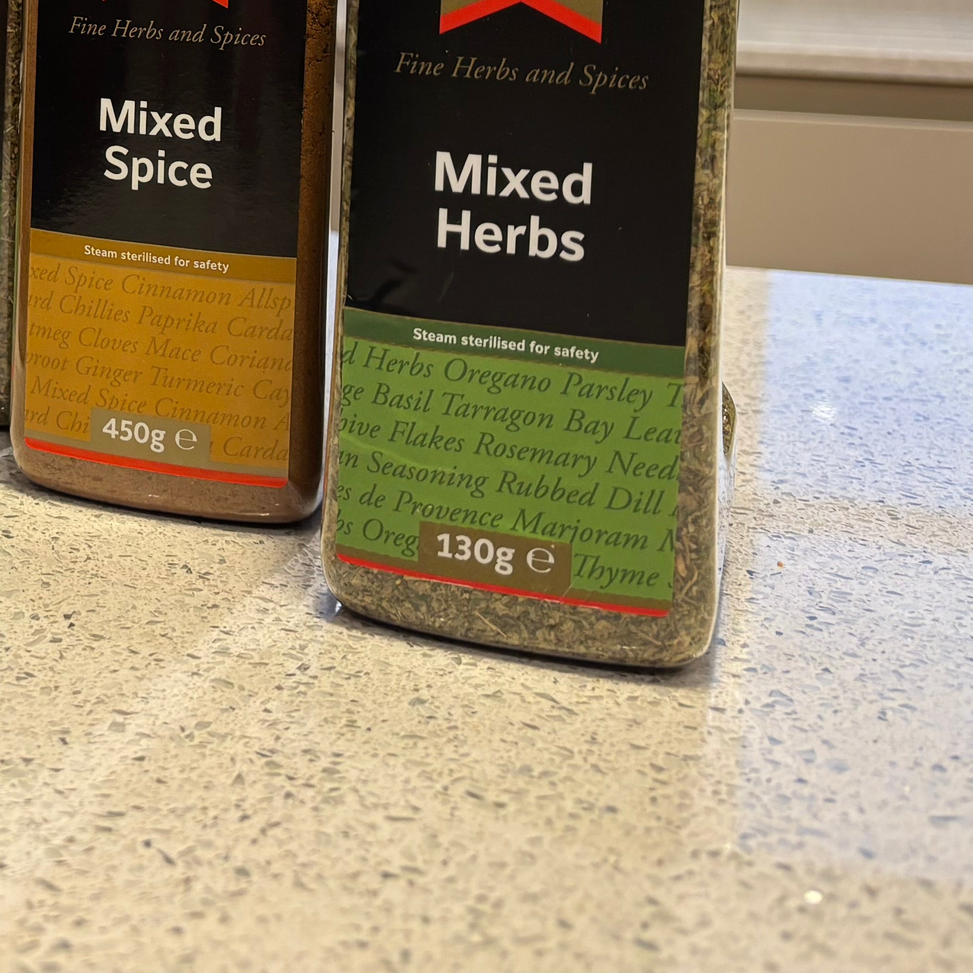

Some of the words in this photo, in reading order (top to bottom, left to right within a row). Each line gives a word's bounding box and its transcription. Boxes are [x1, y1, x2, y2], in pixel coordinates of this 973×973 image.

[69, 15, 106, 36] Fine
[111, 19, 164, 40] Herbs
[169, 24, 207, 43] and
[210, 25, 266, 50] Spices
[394, 51, 443, 76] Fine
[451, 56, 519, 81] Herbs
[526, 62, 571, 86] and
[578, 63, 649, 94] Spices
[99, 97, 222, 142] Mixed
[103, 145, 213, 190] Spice
[434, 150, 593, 204] Mixed
[437, 207, 585, 262] Herbs
[84, 245, 118, 259] Steam
[120, 251, 171, 265] sterilised
[174, 256, 190, 267] for
[193, 258, 229, 273] safety
[64, 266, 114, 293] Spice
[122, 274, 231, 305] Cinnamon
[59, 294, 131, 323] Chillies
[137, 305, 218, 335] Paprika
[78, 327, 139, 354] Cloves
[145, 336, 202, 362] Mace
[413, 328, 457, 345] Steam
[461, 335, 526, 353] sterilised
[529, 341, 550, 355] for
[554, 344, 599, 363] safety
[76, 356, 142, 387] Ginger
[150, 365, 243, 398] Turmeric
[363, 348, 435, 378] Herbs
[444, 358, 551, 394] Oregano
[561, 371, 653, 411] Parsley
[30, 376, 92, 405] Mixed
[96, 388, 147, 413] Spice
[155, 397, 273, 430] Cinnamon
[372, 382, 435, 413] Basil
[441, 392, 554, 433] Tarragon
[563, 409, 615, 445] Bay
[102, 418, 166, 453] 450g
[389, 420, 465, 452] Flakes
[474, 431, 597, 476] Rosemary
[367, 451, 489, 498] Seasoning
[497, 470, 600, 507] Rubbed
[605, 486, 665, 516] Dill
[359, 483, 386, 507] de
[393, 490, 504, 528] Provence
[510, 508, 649, 552] Marjoram
[436, 533, 515, 575] 130g
[573, 553, 660, 589] Thyme
